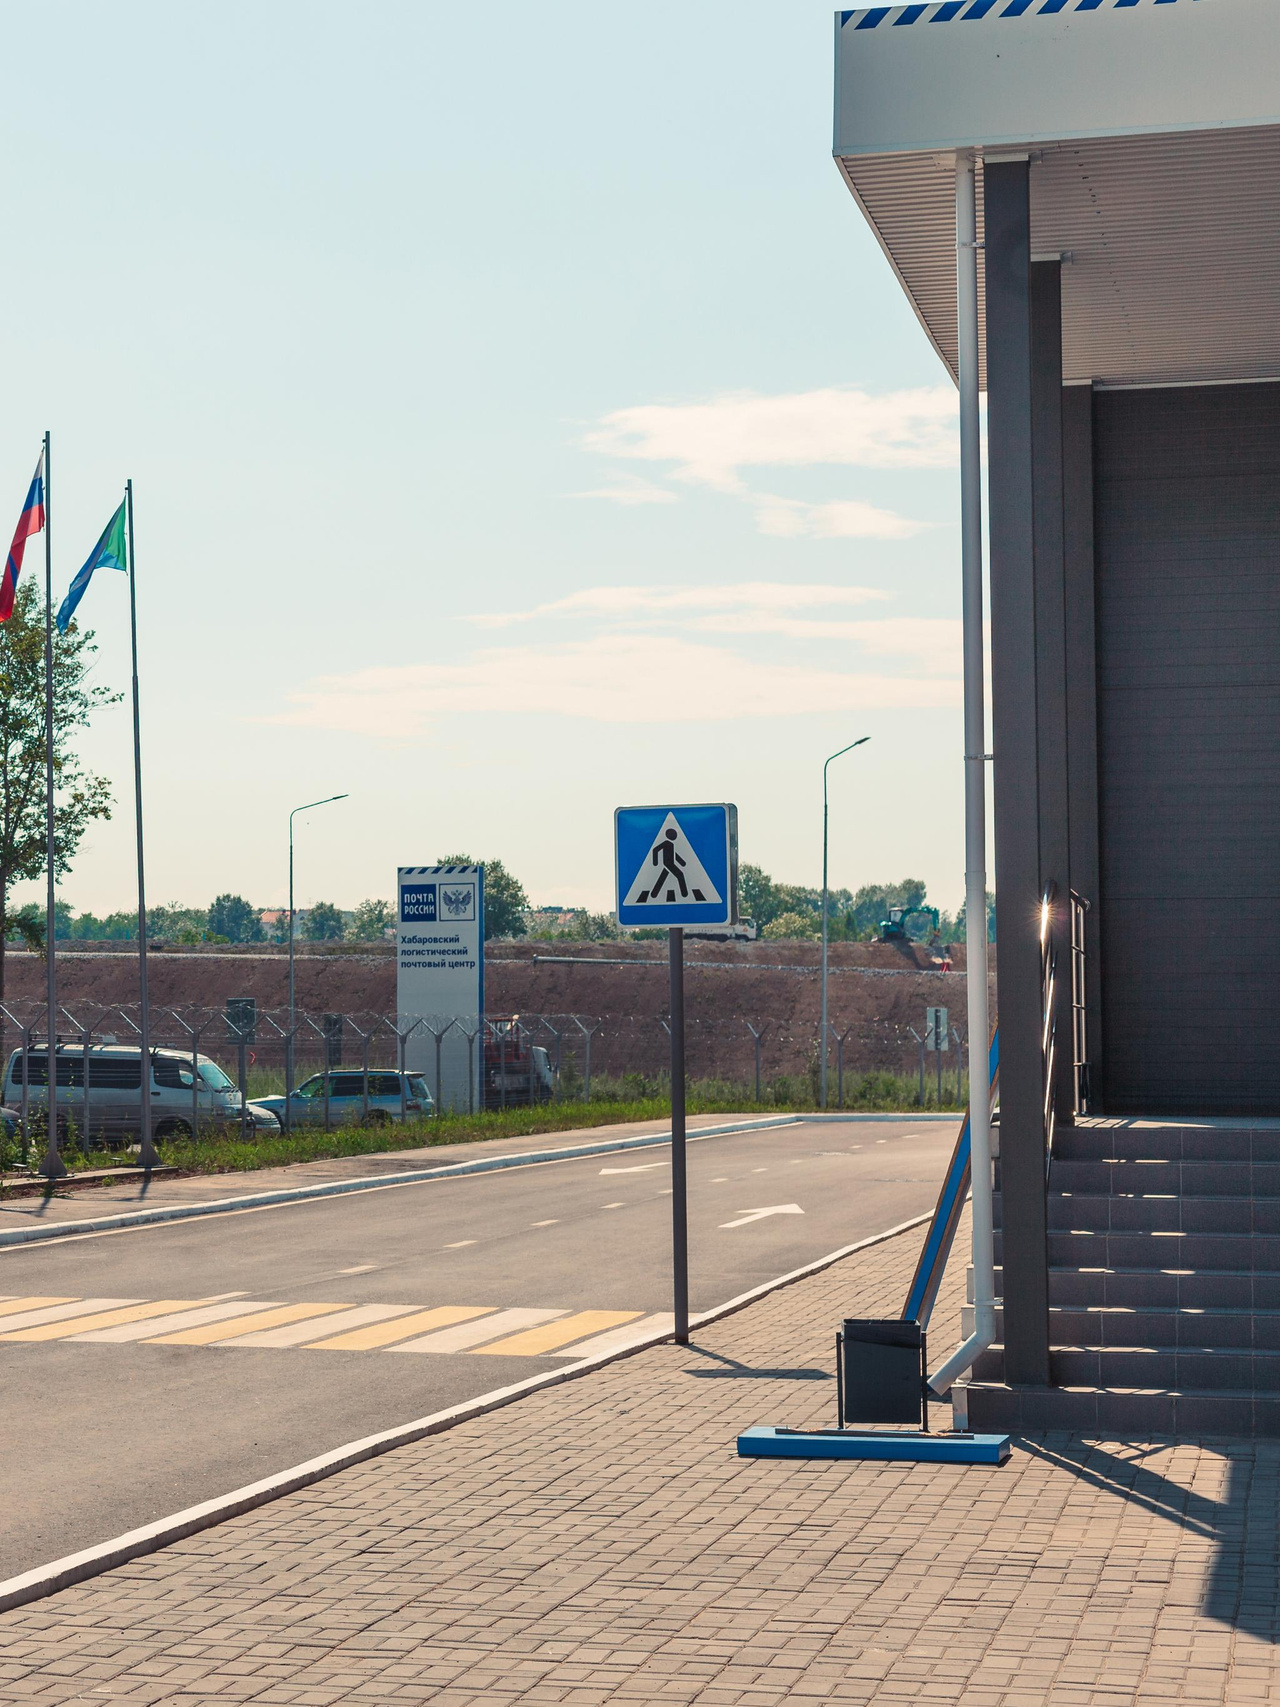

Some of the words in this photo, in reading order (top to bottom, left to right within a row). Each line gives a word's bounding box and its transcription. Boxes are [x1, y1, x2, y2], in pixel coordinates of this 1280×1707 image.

[404, 893, 434, 903] ПОЧТА
[404, 904, 435, 915] РОССИИ
[401, 934, 460, 945] Хабаровский
[401, 946, 468, 956] логистический
[401, 959, 446, 968] почтовый
[448, 960, 476, 969] центр
